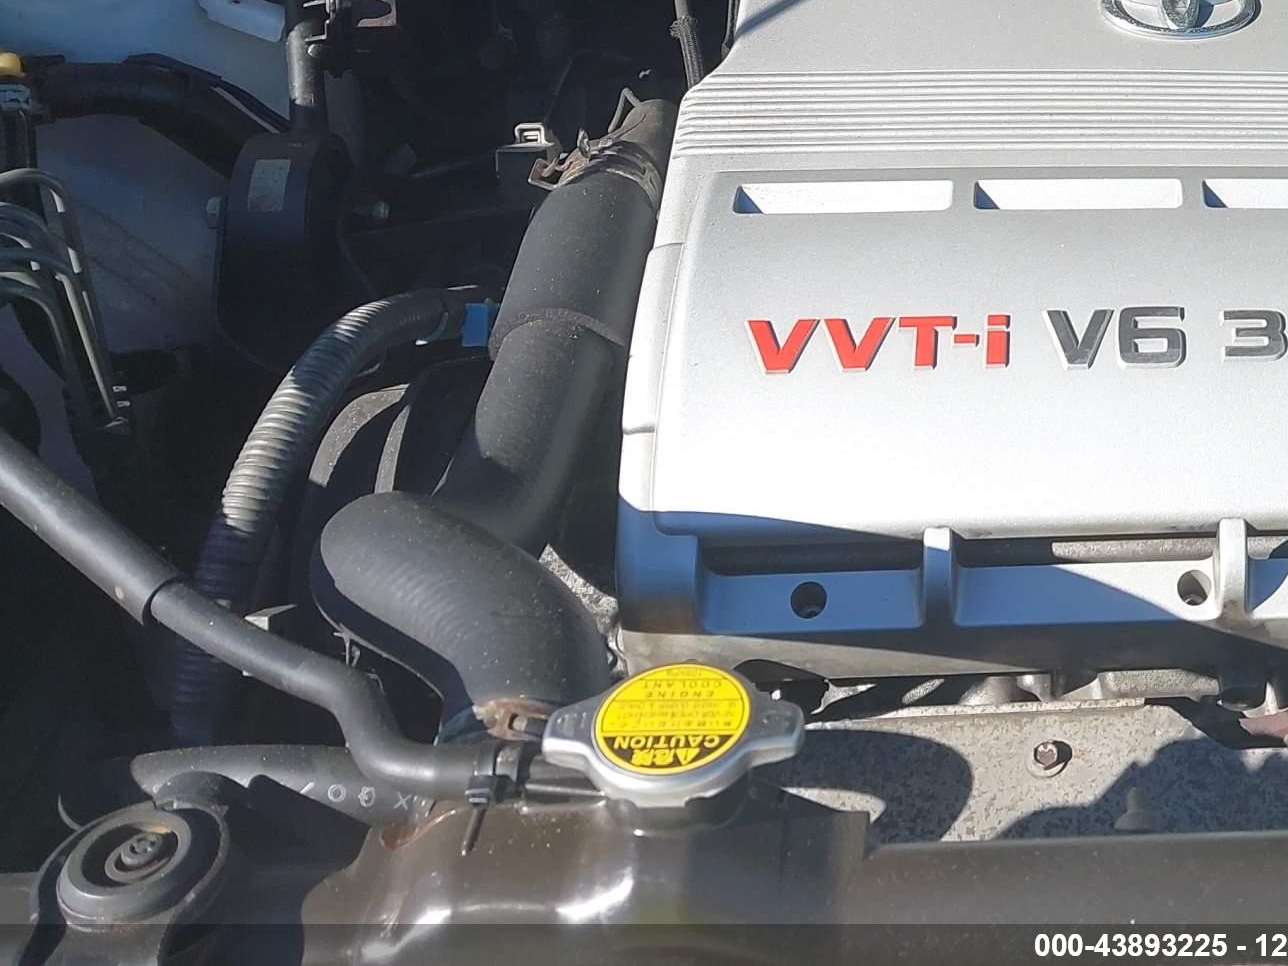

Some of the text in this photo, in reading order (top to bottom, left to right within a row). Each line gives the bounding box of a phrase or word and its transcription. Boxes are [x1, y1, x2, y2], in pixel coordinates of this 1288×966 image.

[745, 312, 1012, 374] VVT-i
[1042, 306, 1186, 371] V6
[642, 680, 722, 690] COOLANT
[645, 689, 715, 698] ENGINE
[613, 735, 720, 749] CAUTION
